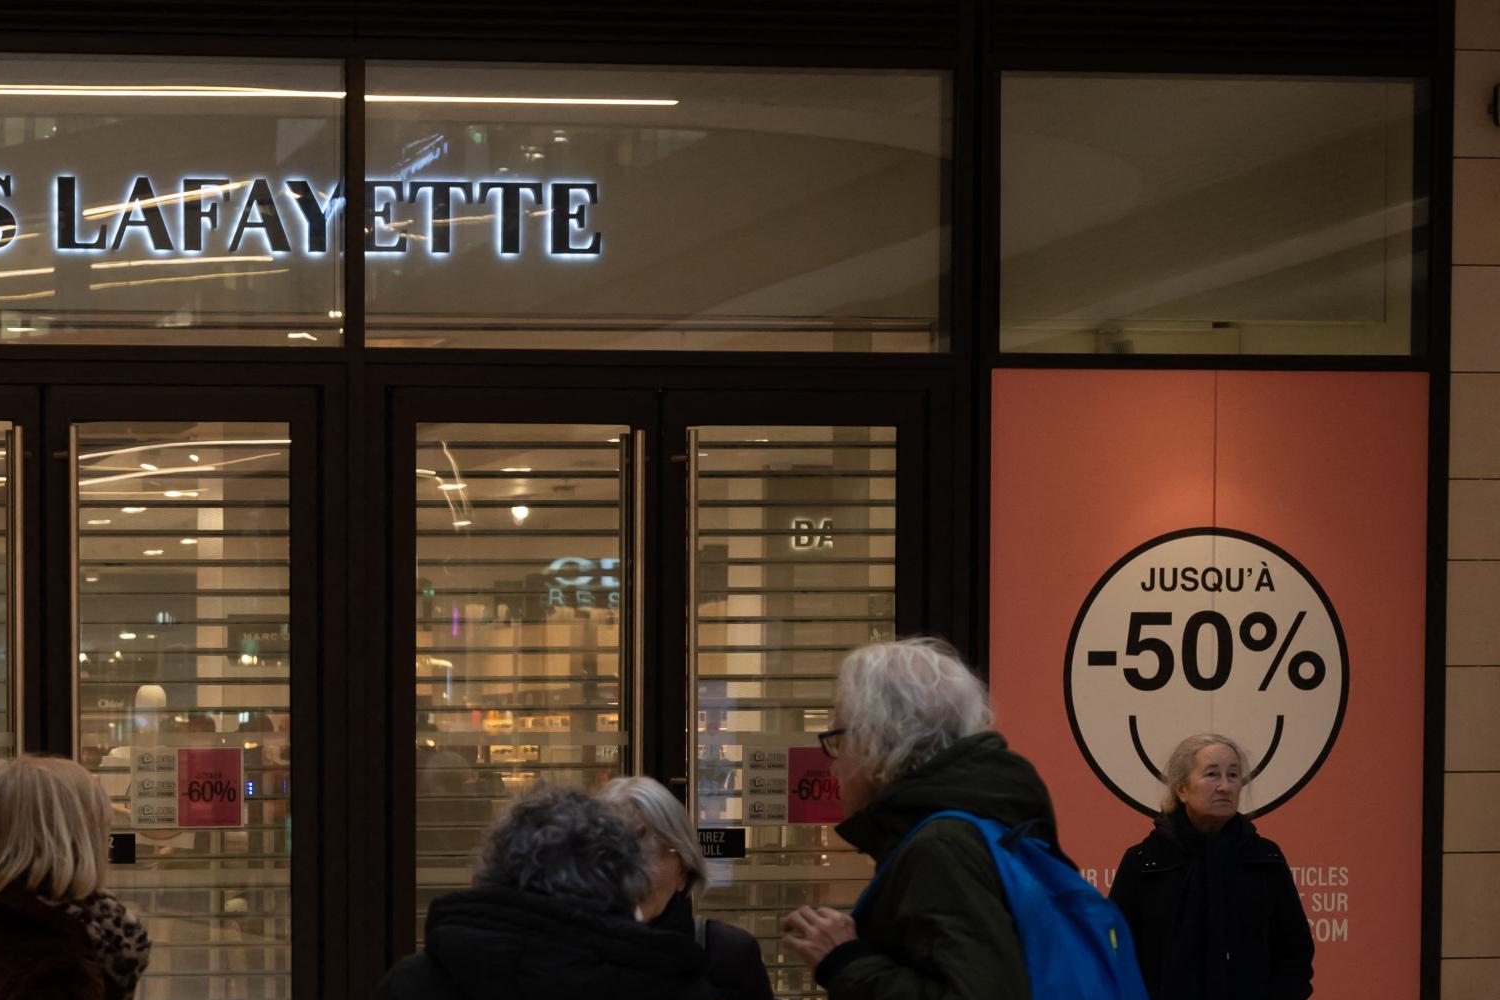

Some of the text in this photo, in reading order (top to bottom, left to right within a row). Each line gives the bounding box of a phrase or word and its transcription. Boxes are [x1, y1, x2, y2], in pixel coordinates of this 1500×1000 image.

[56, 176, 602, 256] LAFAYETTE
[1140, 561, 1276, 593] JUSQU'À
[1087, 611, 1327, 692] -50%
[181, 780, 237, 803] -60%
[791, 778, 842, 801] -60%
[1290, 866, 1349, 887] TICLES
[1312, 893, 1349, 912] SUR
[1308, 918, 1349, 942] OM
